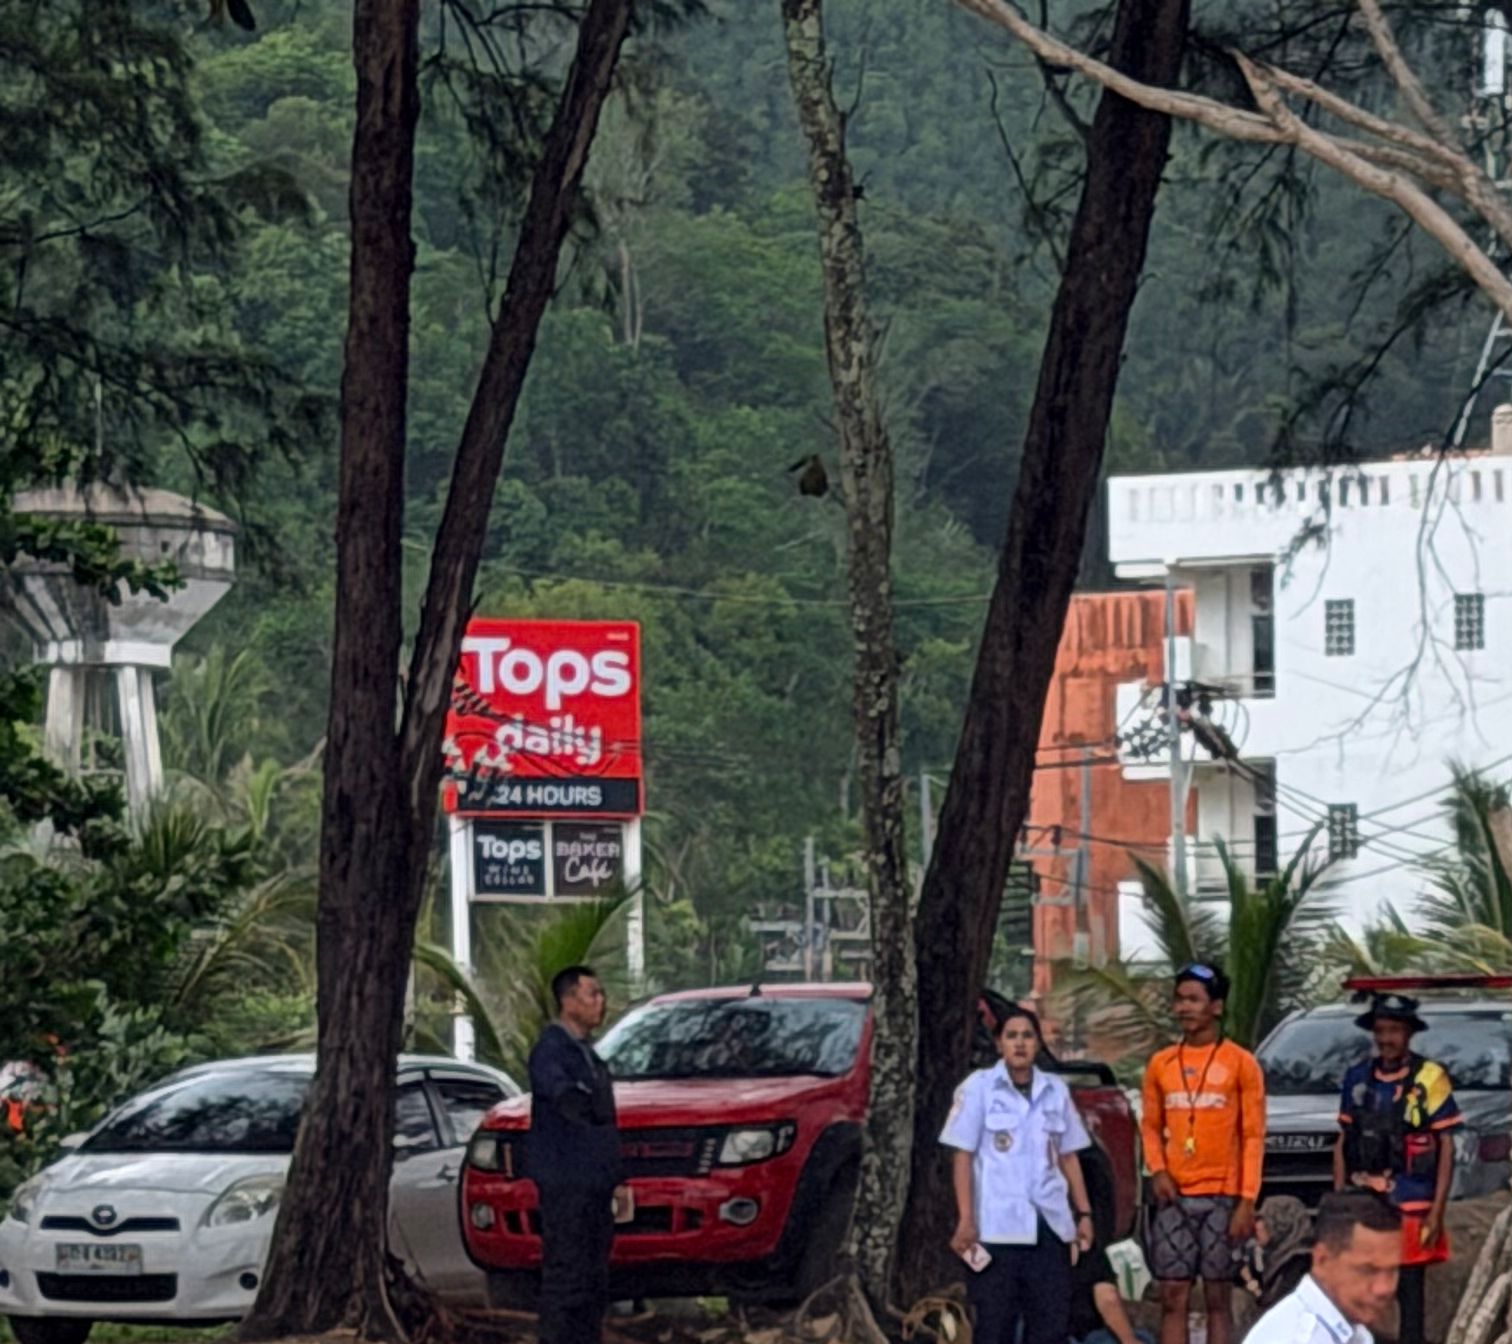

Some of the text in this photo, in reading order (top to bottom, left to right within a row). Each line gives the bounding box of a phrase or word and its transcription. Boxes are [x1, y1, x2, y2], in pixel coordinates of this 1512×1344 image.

[462, 637, 631, 710] Tops
[495, 714, 602, 766] daily
[495, 785, 602, 807] 24 HOURS
[477, 834, 542, 866] Tops
